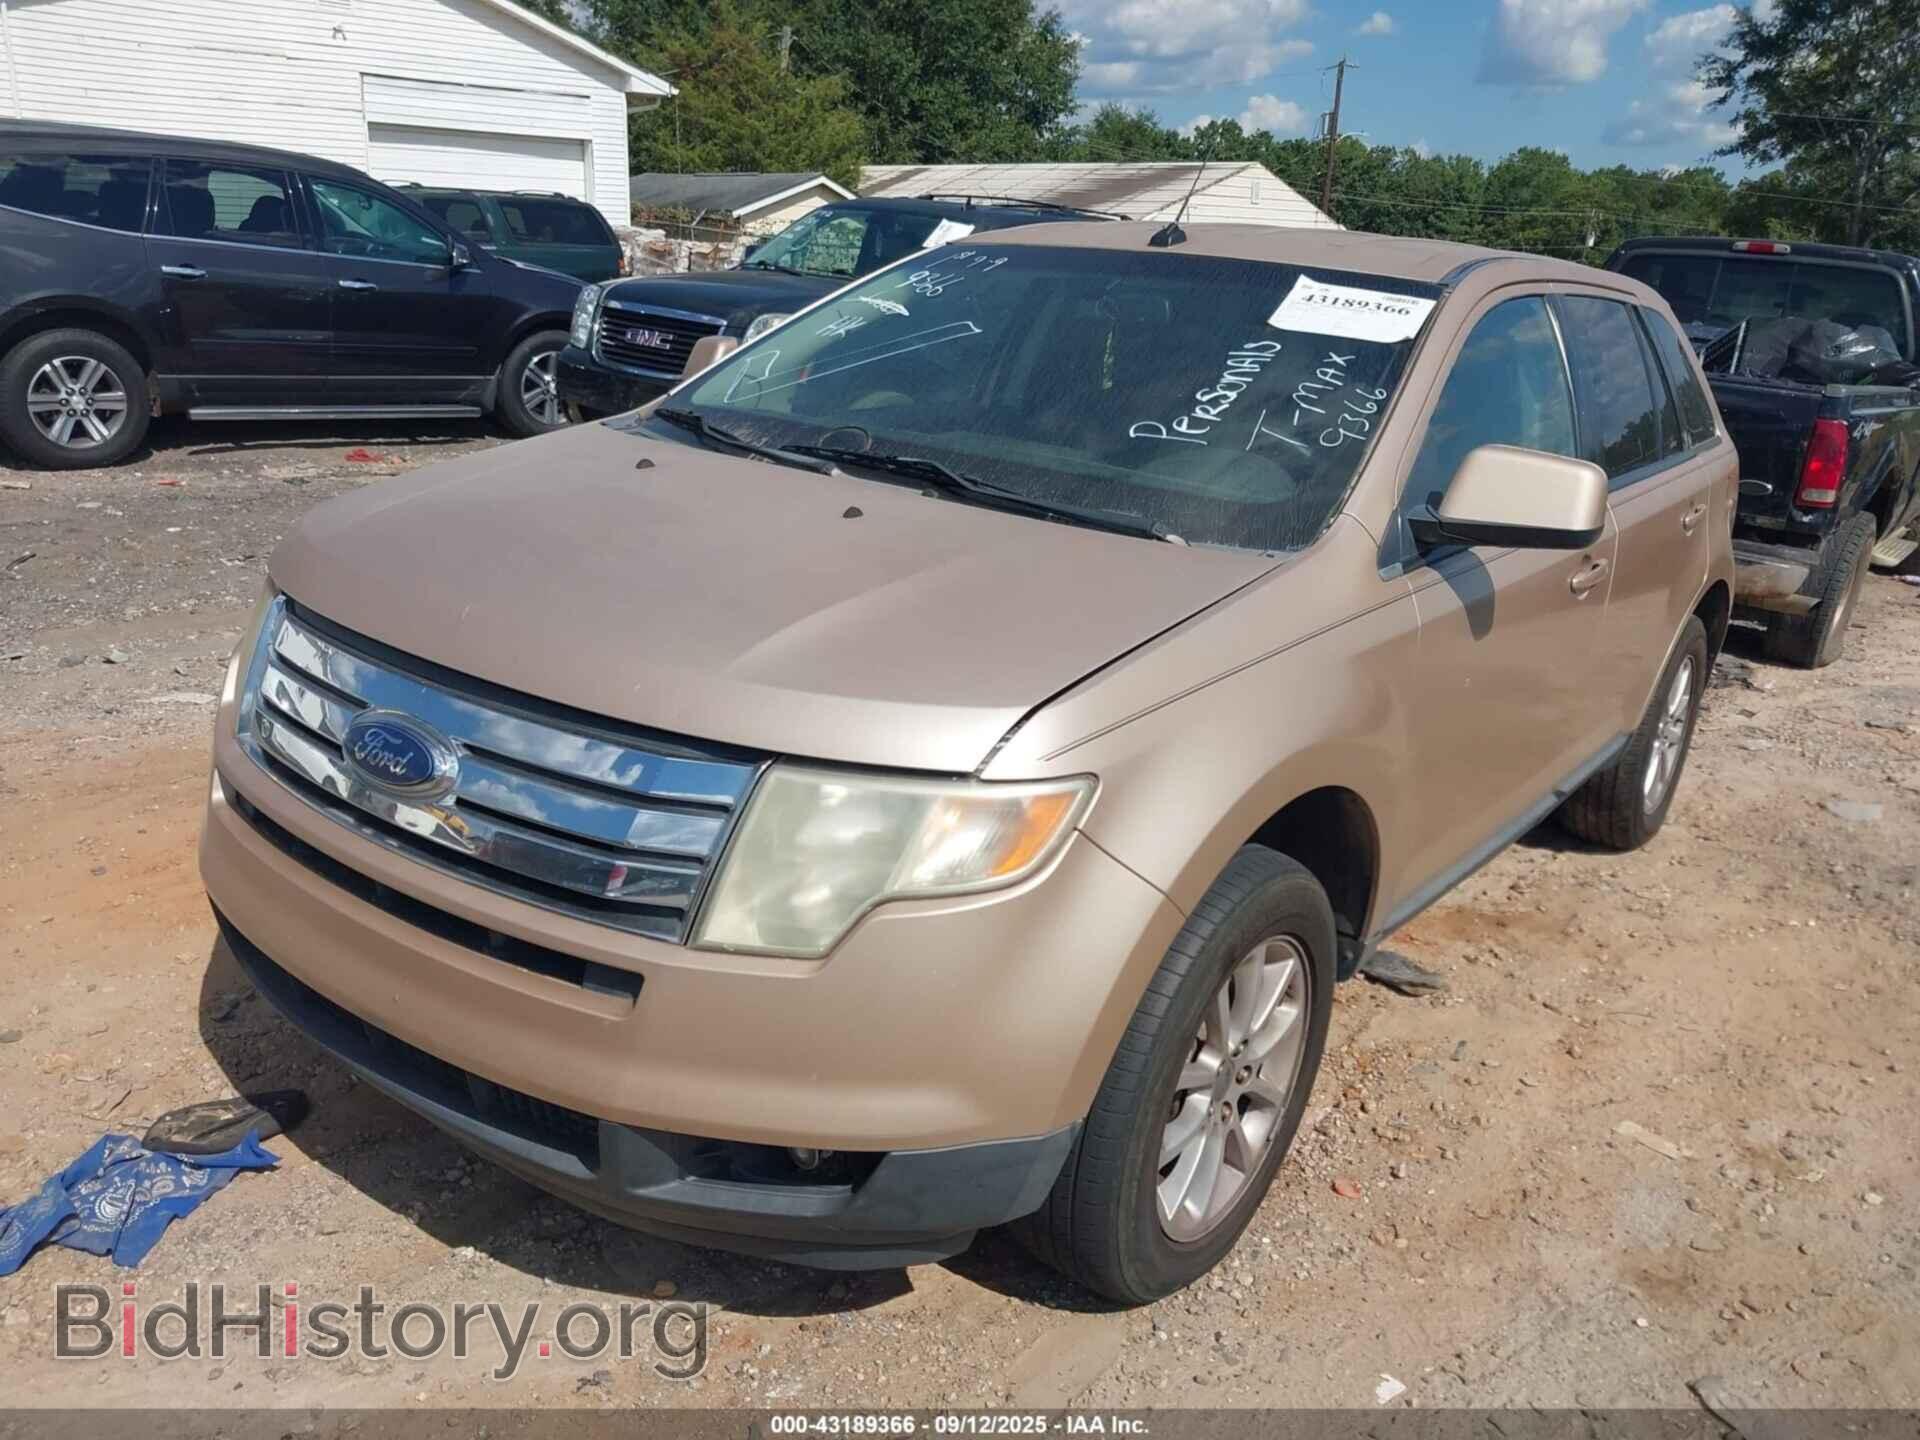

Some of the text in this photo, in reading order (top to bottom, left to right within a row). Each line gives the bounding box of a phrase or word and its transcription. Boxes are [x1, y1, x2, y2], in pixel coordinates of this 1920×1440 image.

[1302, 293, 1411, 317] 43189366
[625, 327, 673, 350] GMC
[1246, 352, 1356, 455] T-MAX
[1319, 388, 1388, 448] 9366
[354, 728, 414, 775] Ford
